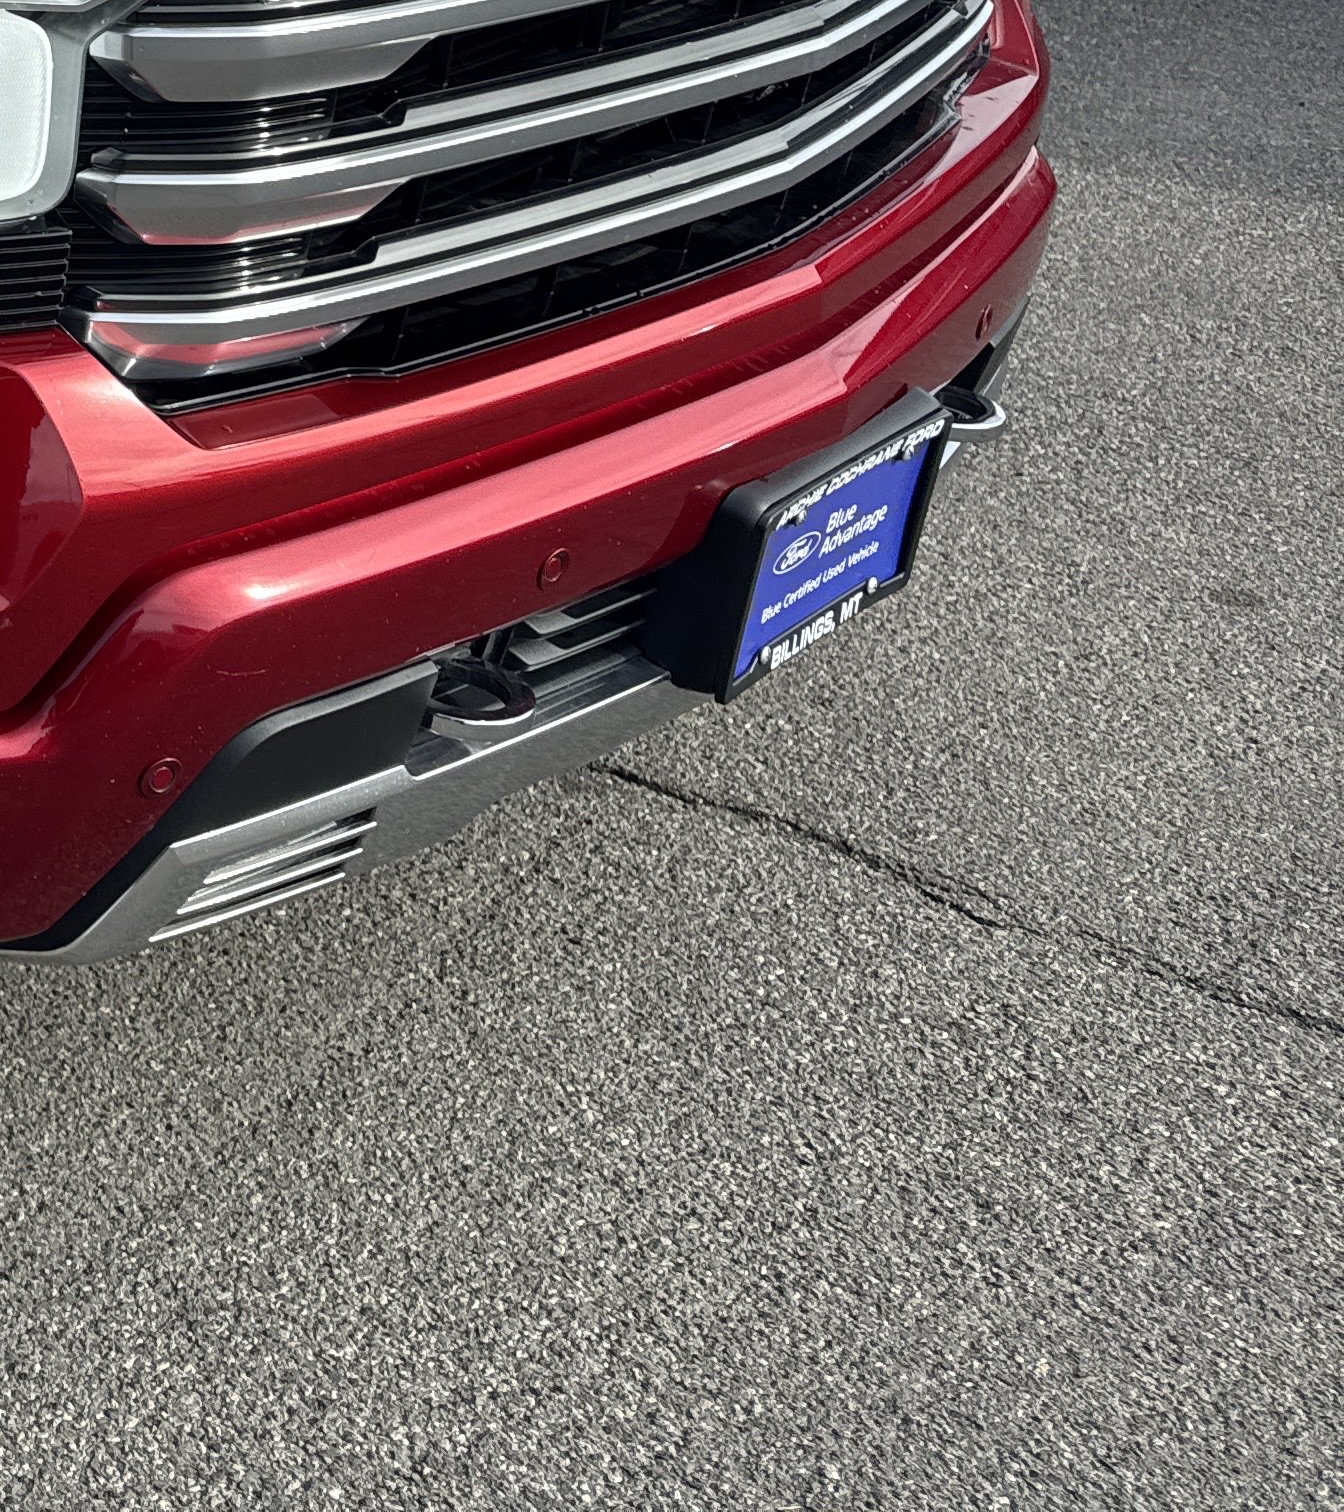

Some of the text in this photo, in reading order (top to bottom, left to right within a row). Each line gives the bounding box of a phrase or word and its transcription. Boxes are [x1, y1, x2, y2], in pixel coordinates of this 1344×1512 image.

[776, 484, 828, 531] ARCHIE
[902, 419, 945, 451] FORD
[818, 504, 888, 558] Advantage
[826, 504, 857, 533] Blue
[761, 541, 879, 624] Blue Certified Used Vehicle
[781, 538, 813, 570] Ford
[770, 592, 863, 670] BILLINGS, MT
